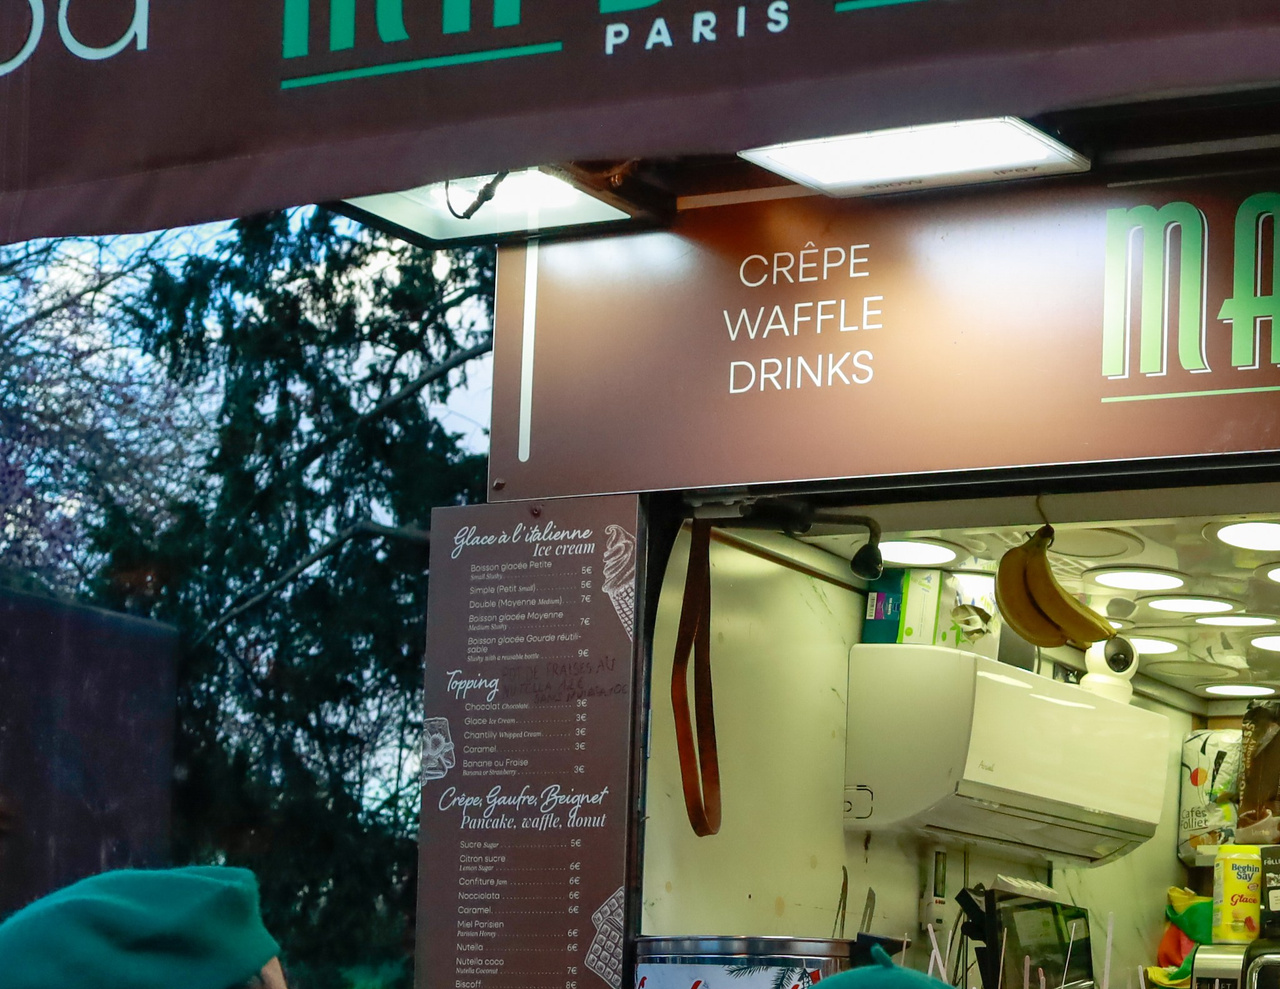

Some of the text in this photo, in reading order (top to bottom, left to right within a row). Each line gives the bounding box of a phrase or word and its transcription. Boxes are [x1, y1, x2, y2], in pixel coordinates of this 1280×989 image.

[604, 0, 792, 55] PARIS
[993, 166, 1039, 176] IP67
[740, 241, 874, 290] CRÊPE
[724, 293, 886, 344] WAFFLE
[730, 350, 878, 397] DRINKS
[451, 521, 593, 559] Glace l'italienne
[533, 543, 595, 556] Ice cream
[501, 562, 527, 572] glacée
[582, 566, 592, 574] 5€
[497, 585, 516, 593] (Petit
[470, 600, 496, 608] Double
[498, 599, 536, 608] (Moyenne
[527, 612, 563, 620] Moyenne
[498, 634, 555, 645] glacée Gourde
[577, 649, 590, 657] 9€
[447, 670, 499, 702] Topping
[465, 699, 587, 711] Chocolat 3€
[465, 713, 586, 725] Glace 3€
[464, 728, 586, 739] Chantilly 3€
[463, 742, 585, 753] Caramel 3€
[574, 765, 584, 773] 3€
[439, 785, 609, 821] Crêpe, Gaufre, Beignet
[1180, 808, 1207, 820] Cafés
[461, 809, 606, 830] Pancake, waffle, donut
[571, 839, 581, 847] 5€
[570, 862, 580, 870] 6€
[1231, 863, 1260, 873] Beghin
[459, 877, 580, 885] Confiture 6€
[1236, 871, 1255, 883] Say
[569, 891, 579, 899] 6€
[458, 906, 493, 914] Caramel
[475, 920, 504, 928] Parisien
[568, 929, 578, 937] 6€
[456, 980, 576, 989] Biscoff 8€
